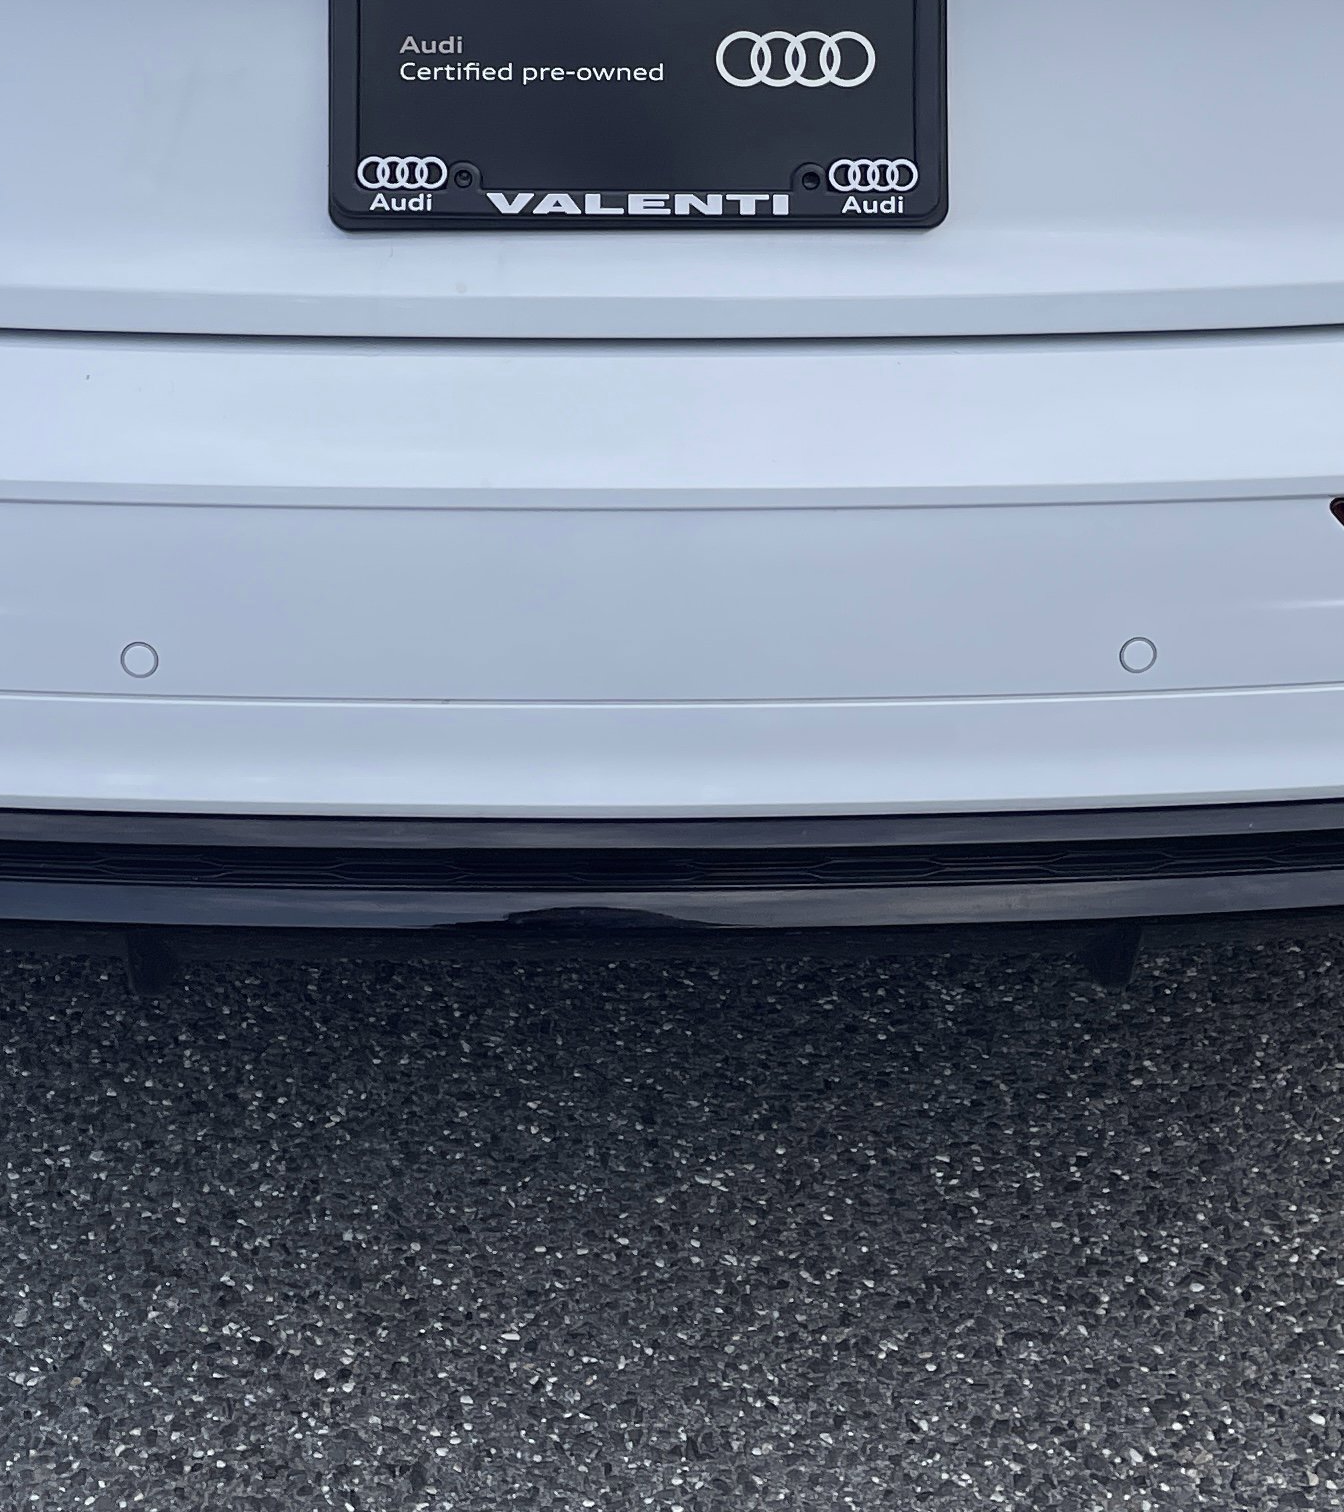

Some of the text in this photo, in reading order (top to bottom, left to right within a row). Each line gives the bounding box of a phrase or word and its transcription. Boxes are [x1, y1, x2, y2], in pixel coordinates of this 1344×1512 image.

[399, 35, 464, 54] Audi
[399, 61, 665, 86] Certified pre-owned
[368, 192, 433, 212] Audi
[486, 192, 790, 215] VALENTI
[841, 194, 905, 214] Audi
